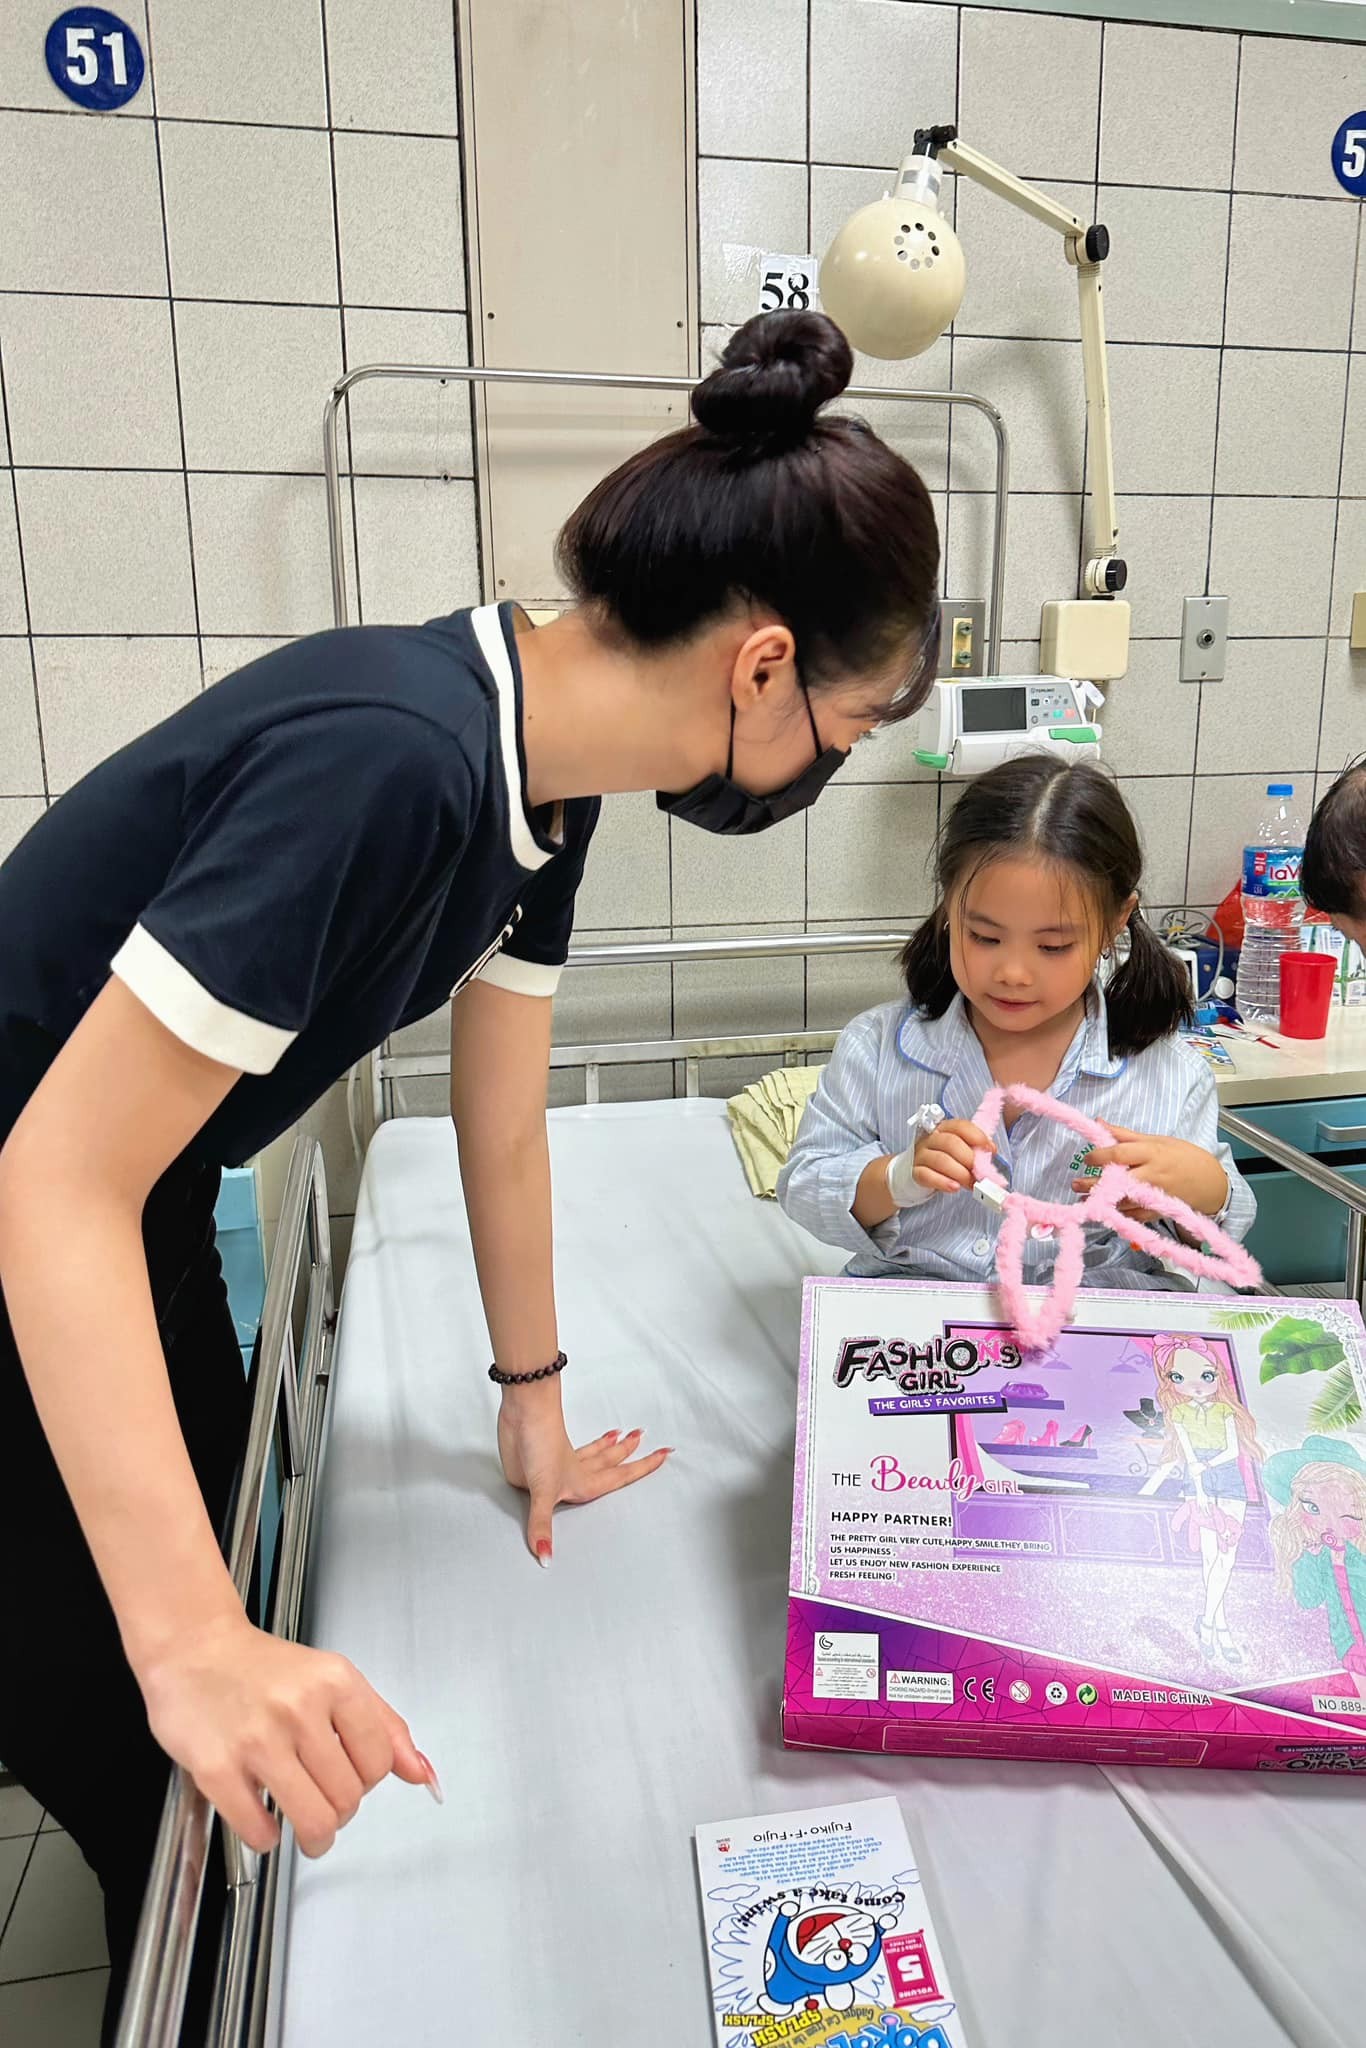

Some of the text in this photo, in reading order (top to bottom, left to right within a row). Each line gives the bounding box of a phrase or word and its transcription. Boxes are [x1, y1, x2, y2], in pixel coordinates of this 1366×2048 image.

[66, 27, 127, 86] 51
[1342, 129, 1366, 178] 5
[761, 271, 810, 312] 58
[1270, 864, 1302, 881] laV
[835, 1337, 1022, 1386] FASHIONS
[900, 1371, 961, 1392] GIRL
[874, 1395, 996, 1410] THE GIRLS' FAVORITES
[832, 1472, 862, 1487] THE
[983, 1479, 1024, 1496] GIRL
[831, 1511, 953, 1527] HAPPY PARTNER!
[830, 1534, 846, 1542] THE
[849, 1535, 877, 1543] PRETTY
[879, 1535, 898, 1544] GIRL
[900, 1537, 920, 1545] VERY
[1023, 1542, 1050, 1551] BRING
[830, 1546, 842, 1554] US
[844, 1547, 891, 1556] HAPPINESS
[830, 1558, 1001, 1573] LET US ENJOY NEW FASHION EXPERIENCE
[829, 1571, 896, 1580] FRESH FEELING!
[901, 1676, 951, 1686] WARNING:
[1113, 1689, 1211, 1705] MADE IN CHINA
[753, 1830, 787, 1842] Fujio
[810, 1821, 853, 1835] Fujiko
[737, 1888, 906, 1927] Come take a swim!
[897, 1954, 925, 1983] 5
[898, 1986, 933, 1999] VOLUME
[723, 2013, 775, 2027] SPLASH
[751, 2009, 823, 2047] SPLASH
